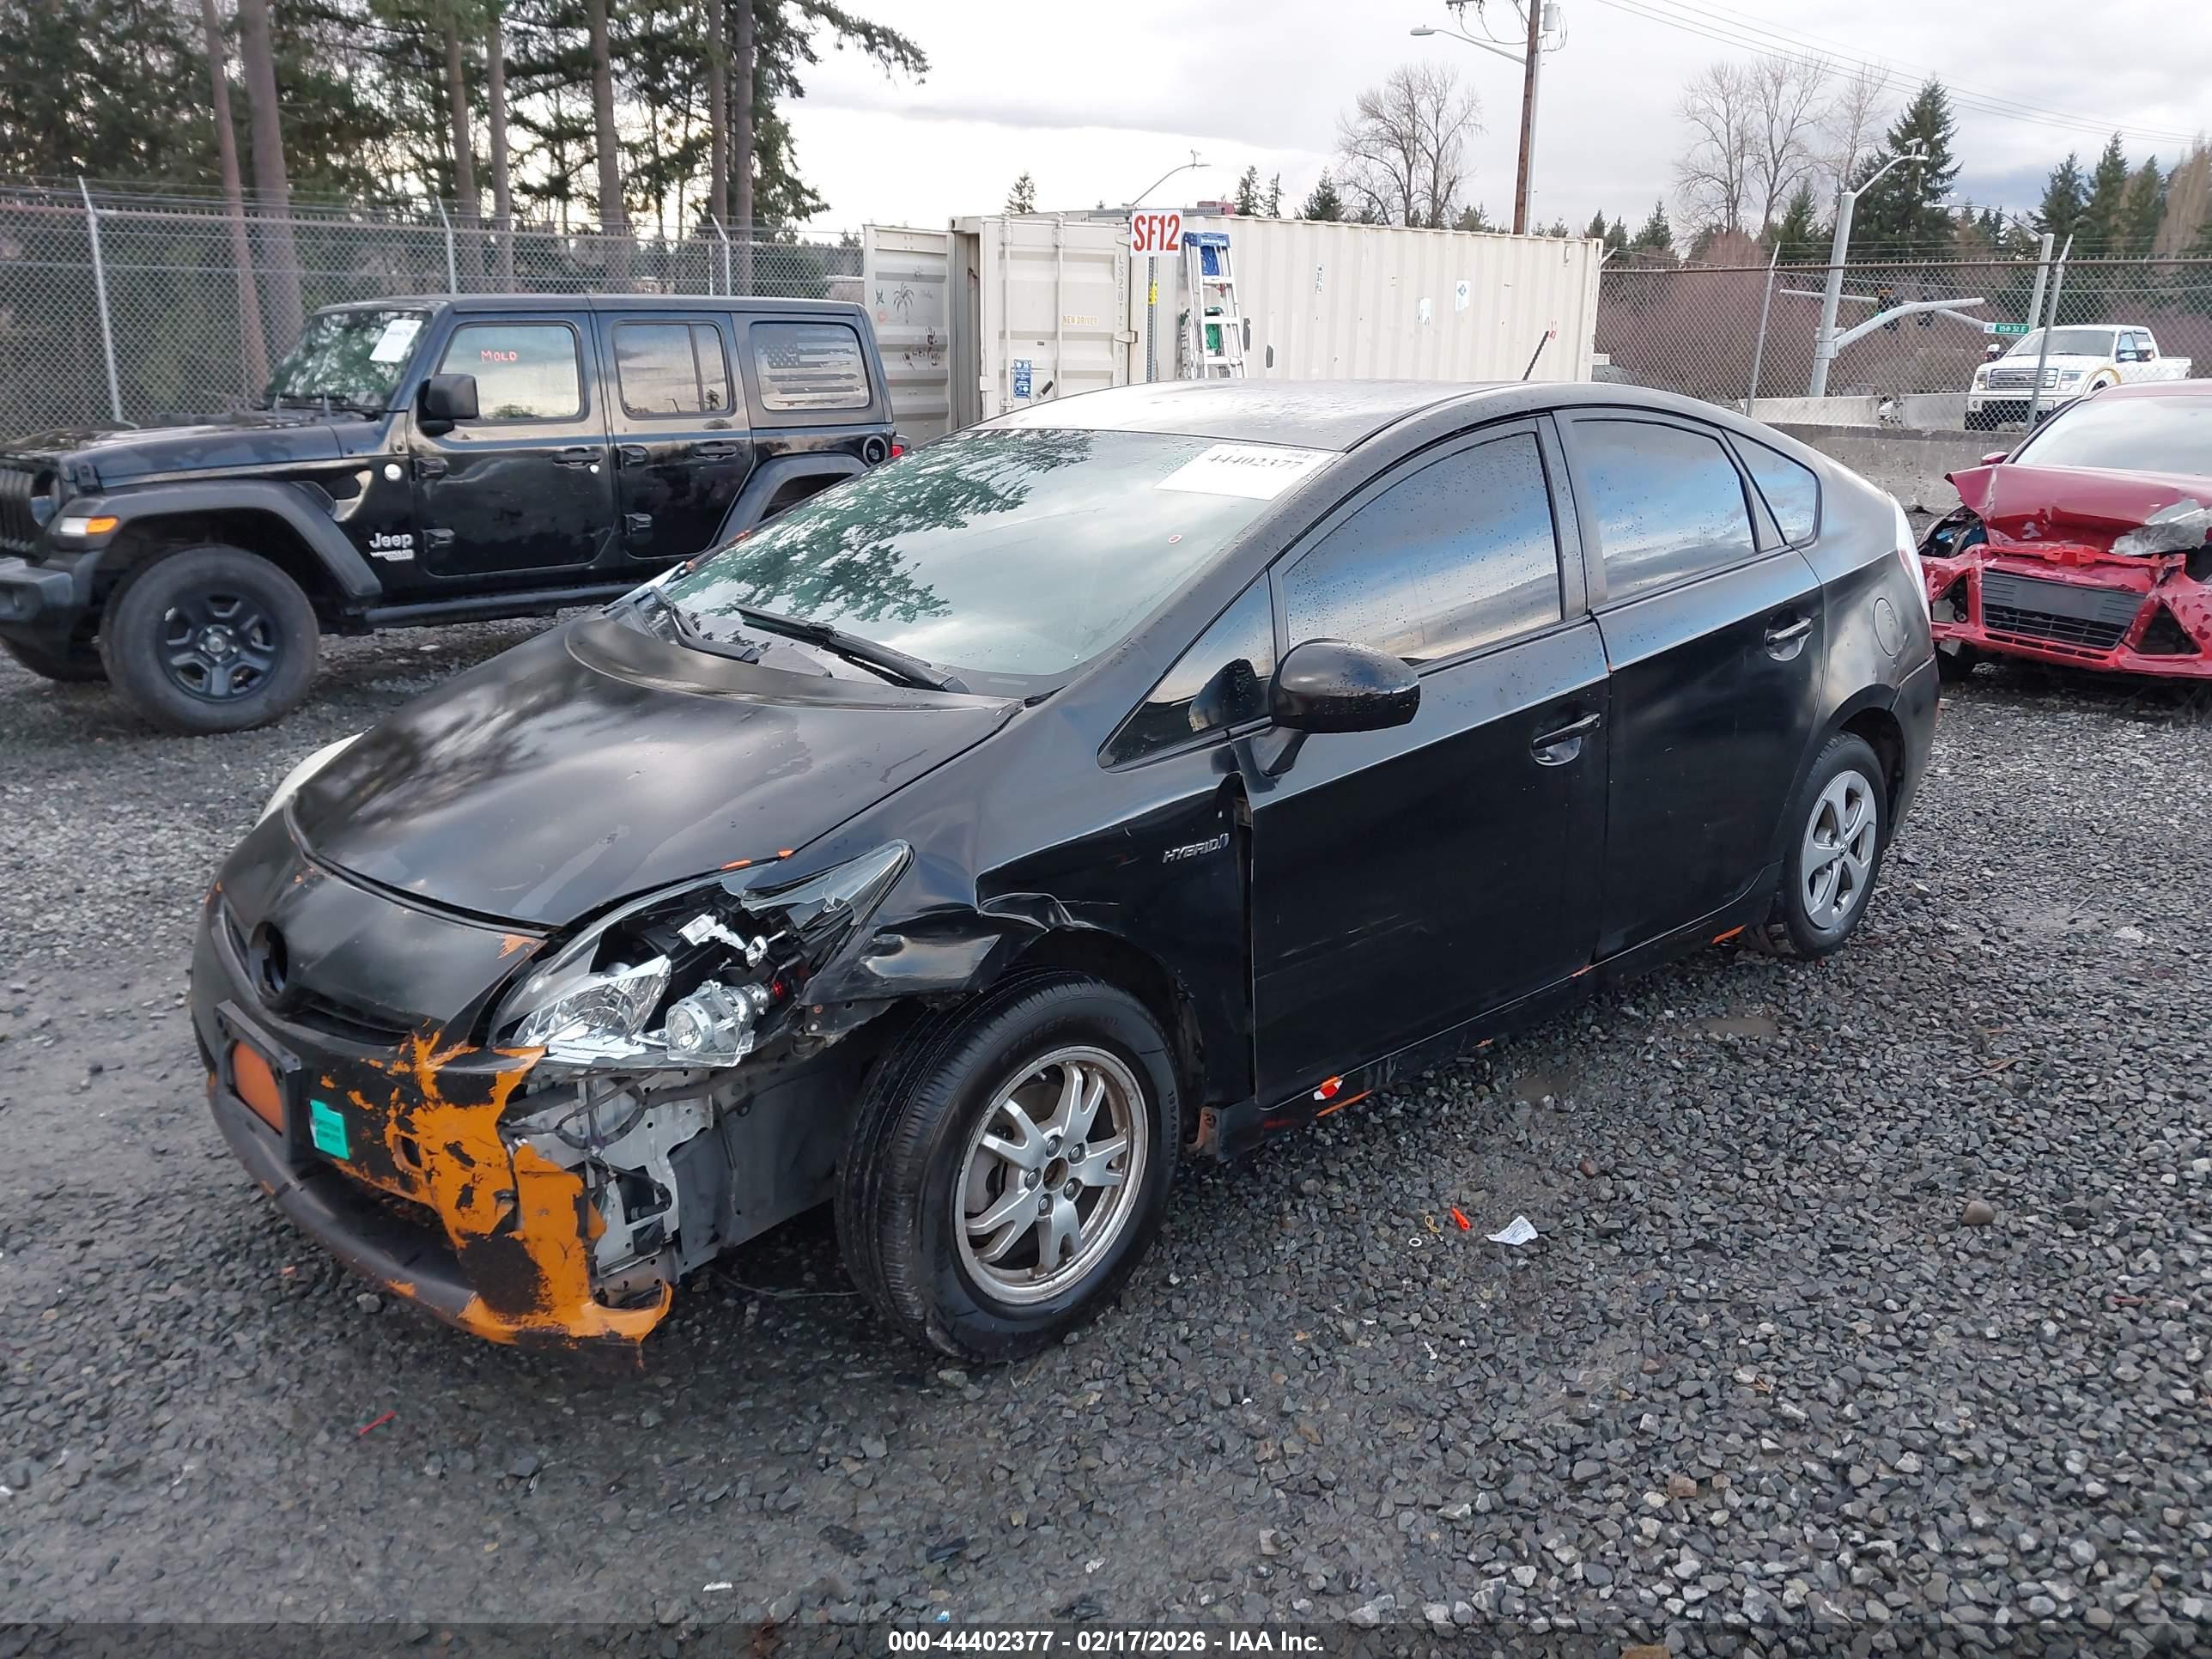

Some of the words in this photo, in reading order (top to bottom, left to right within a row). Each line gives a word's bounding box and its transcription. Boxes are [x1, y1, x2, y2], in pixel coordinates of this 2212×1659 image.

[1133, 215, 1180, 251] SF12
[481, 349, 518, 362] MOLD
[1207, 455, 1304, 470] 44402377
[369, 532, 413, 549] Jeep
[1162, 838, 1219, 864] HYBRID
